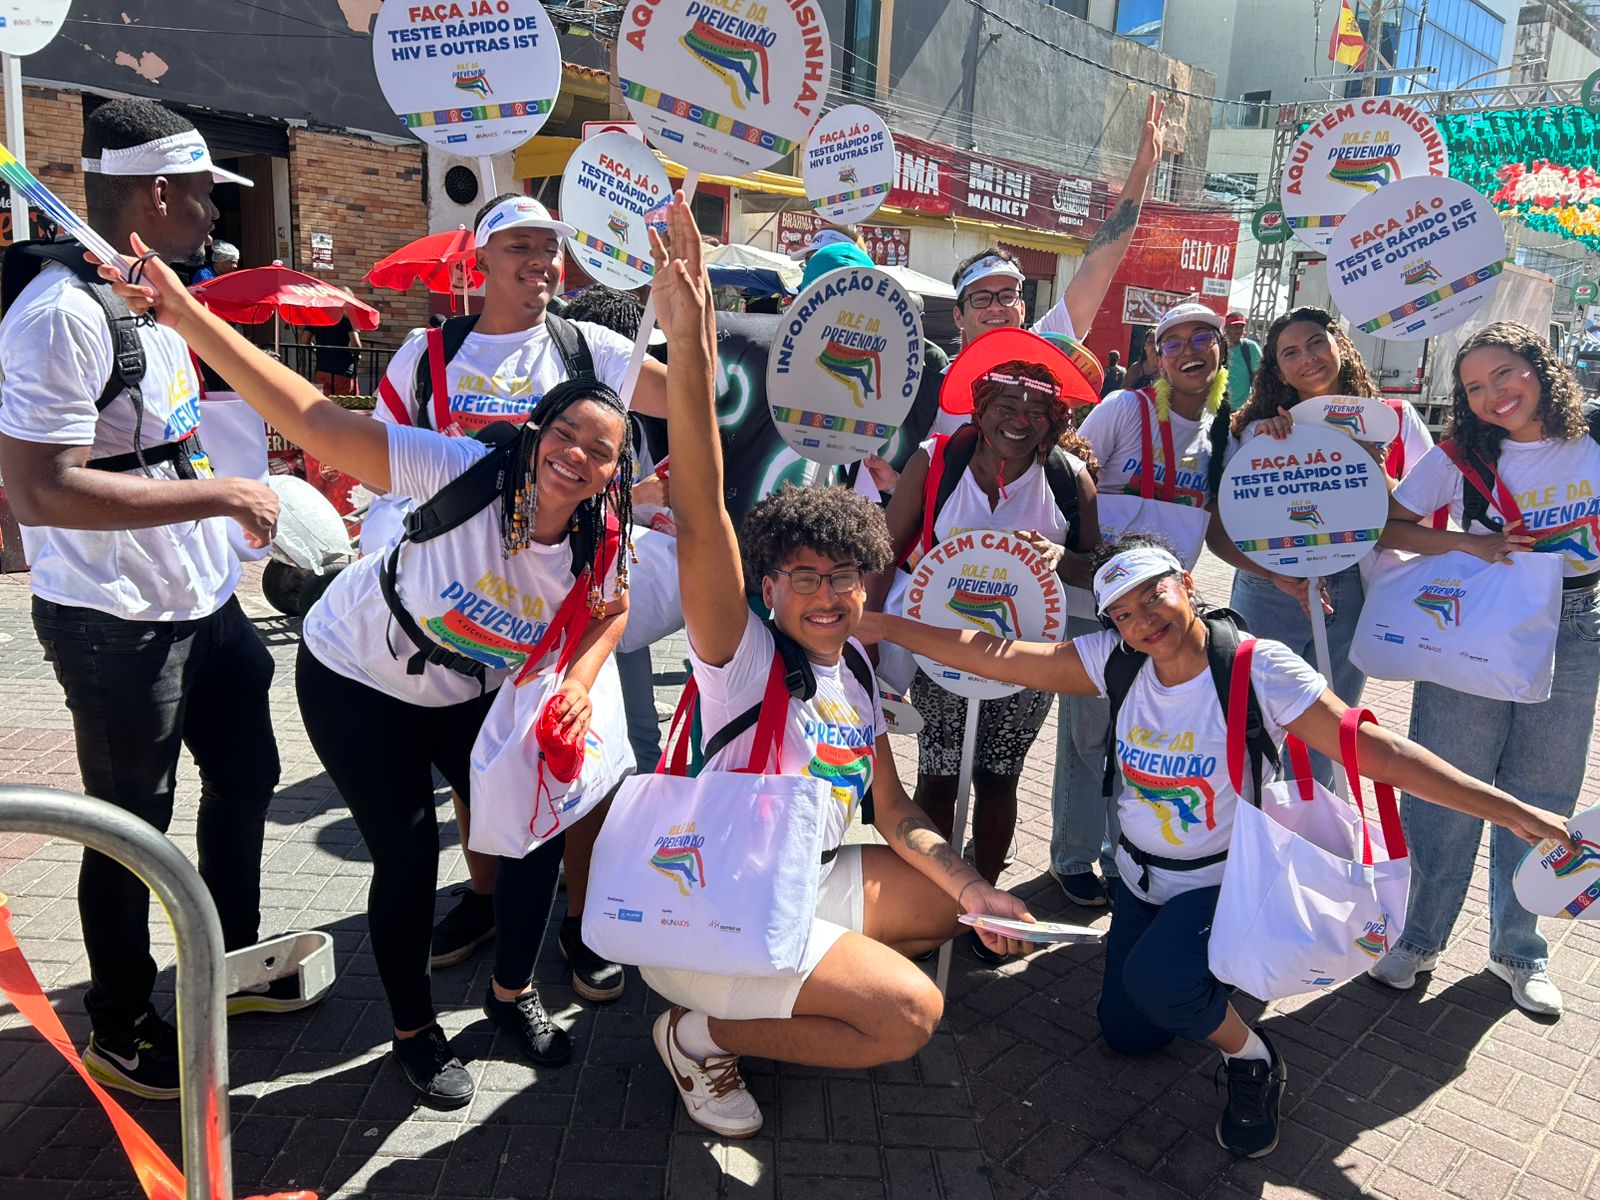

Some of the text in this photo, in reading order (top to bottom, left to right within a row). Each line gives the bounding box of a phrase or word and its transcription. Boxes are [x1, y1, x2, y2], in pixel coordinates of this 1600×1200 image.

[408, 3, 464, 23] FAÇA
[496, 0, 509, 14] O
[388, 16, 537, 43] TESTE RÁPIDO DE
[391, 34, 538, 61] HIV E OUTRAS IST
[809, 131, 884, 159] TESTE RÁPIDO DE
[819, 123, 870, 145] FAÇA JÁ O
[809, 157, 824, 169] HIV
[826, 155, 832, 165] E
[833, 147, 869, 162] OUTRAS
[870, 142, 884, 153] IST
[1286, 140, 1314, 195] AQUI
[1309, 103, 1355, 139] TEM
[577, 174, 598, 192] HIV
[599, 186, 607, 197] E
[581, 160, 655, 207] TESTE RÁPIDO
[599, 153, 659, 195] FAÇA JÁ O
[969, 161, 1032, 200] MINI
[967, 192, 1029, 217] MARKET
[781, 211, 814, 231] BRAHMA
[1350, 197, 1444, 250] FAÇA JÁ O
[1335, 198, 1474, 273] TESTE RÁPIDO DE
[1341, 211, 1478, 286] HIV E OUTRAS IST
[1180, 238, 1213, 272] GELO
[776, 270, 920, 398] INFORMAÇÃO É PROTEÇÃO
[1251, 449, 1342, 471] FAÇA JÁ O
[1231, 463, 1368, 487] TESTE RÁPIDO DE
[1233, 476, 1369, 500] HIV E OUTRAS IST
[1566, 479, 1593, 501] DA
[907, 564, 935, 620] AQUI
[930, 534, 975, 566] TEM
[992, 567, 1008, 581] DA
